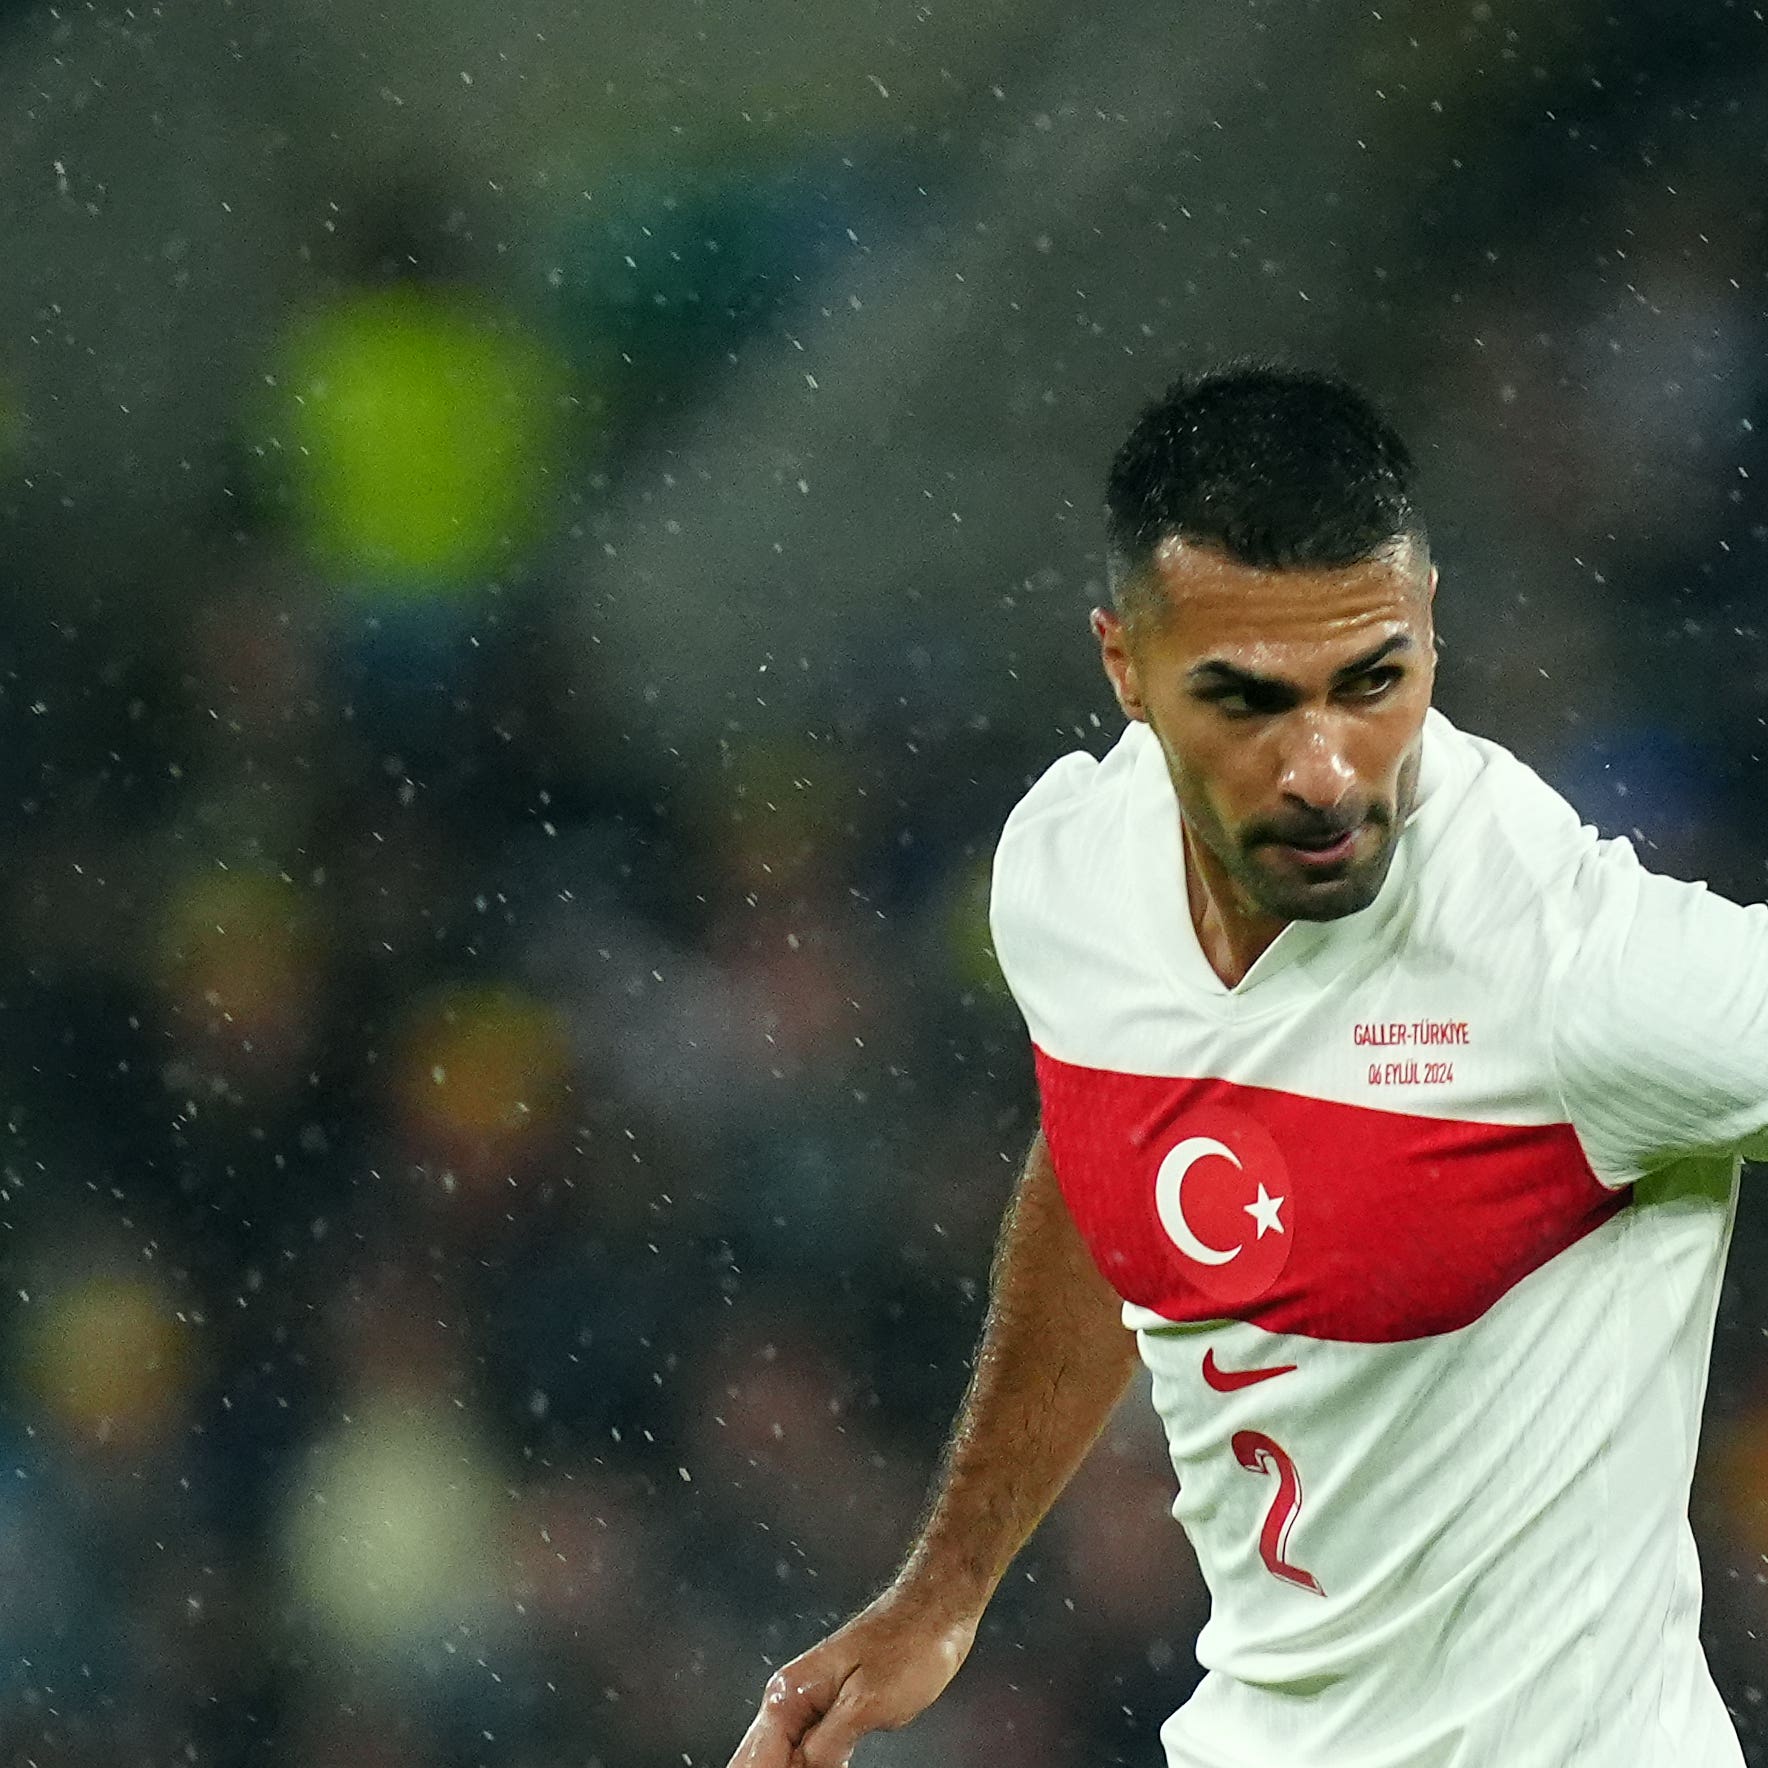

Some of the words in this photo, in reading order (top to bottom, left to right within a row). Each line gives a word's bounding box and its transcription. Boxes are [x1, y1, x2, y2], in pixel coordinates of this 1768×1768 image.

[1354, 1019, 1470, 1046] GALLER-TÜRKİYE
[1368, 1062, 1382, 1085] 06
[1384, 1057, 1421, 1085] EYLÜL
[1423, 1061, 1454, 1084] 2024
[1231, 1430, 1328, 1598] 2
